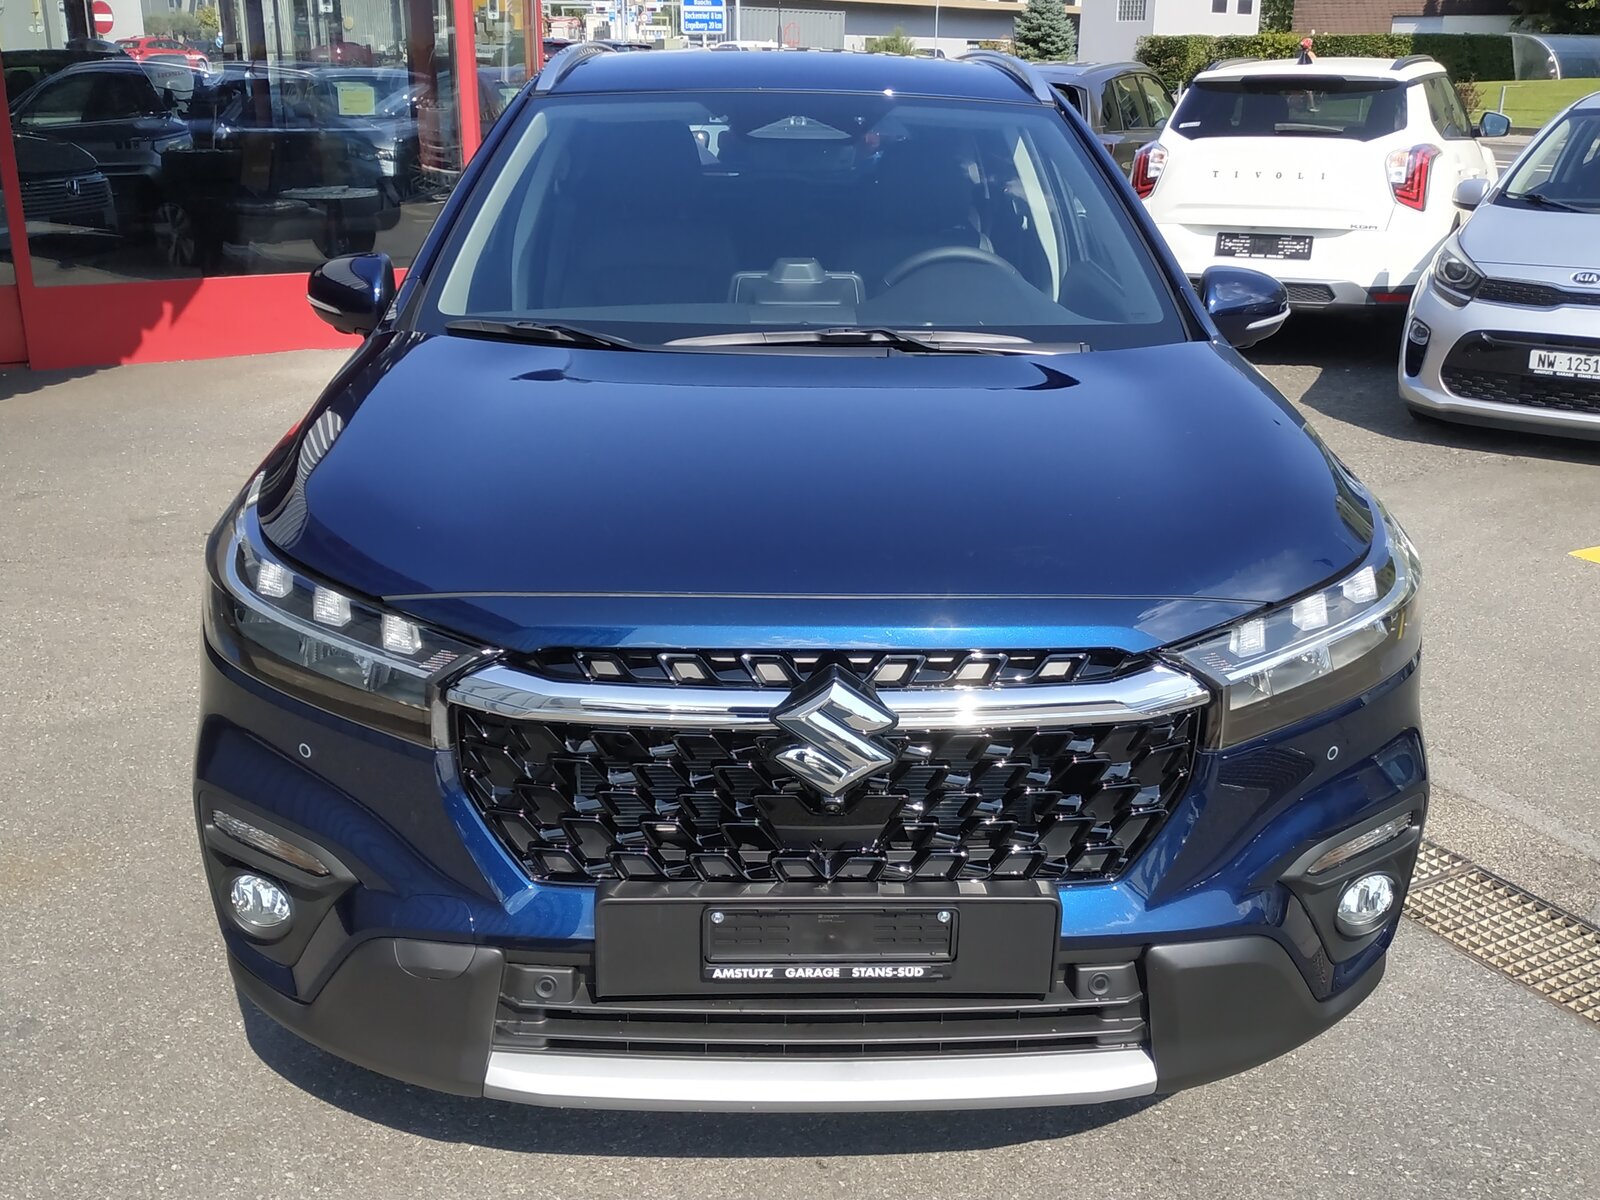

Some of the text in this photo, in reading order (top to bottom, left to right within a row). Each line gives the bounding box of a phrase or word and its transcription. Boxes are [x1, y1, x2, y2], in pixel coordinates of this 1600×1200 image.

[685, 21, 722, 30] Engelberg 20 km
[1212, 170, 1325, 180] TIVOLI
[1576, 273, 1597, 282] KIA
[1537, 353, 1600, 373] NW 1251
[712, 966, 924, 979] AMSTUTZ GARAGE STANS-SÜD
